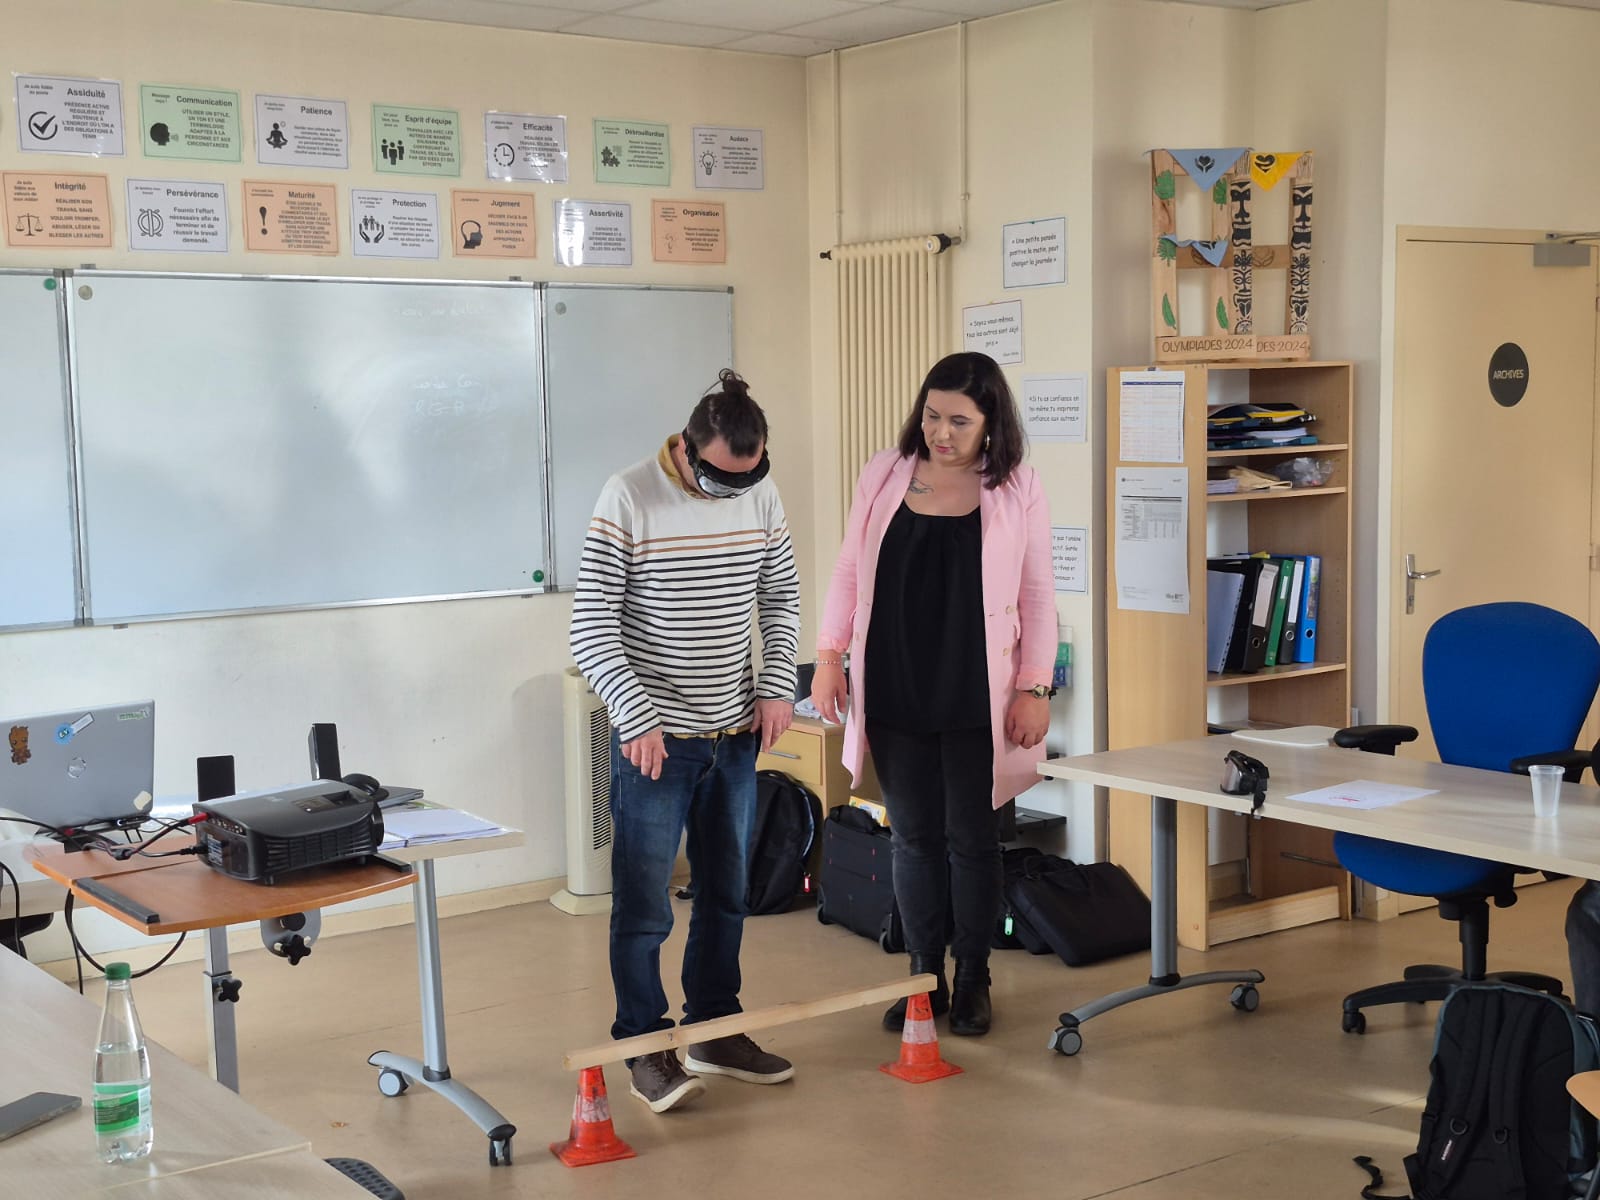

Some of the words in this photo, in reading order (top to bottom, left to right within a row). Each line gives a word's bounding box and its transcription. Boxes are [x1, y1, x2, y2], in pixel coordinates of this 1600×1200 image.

[67, 88, 106, 98] Assiduité
[177, 96, 232, 106] Communication
[301, 106, 332, 115] Patience
[405, 115, 424, 123] Esprit
[425, 117, 452, 126] d'équipe
[523, 123, 553, 131] Efficacité
[55, 182, 86, 191] Intégrité
[166, 188, 219, 198] Persévérance
[392, 199, 426, 208] Protection
[589, 209, 623, 218] Assertivité
[683, 209, 720, 217] Organisation
[1162, 339, 1222, 353] OLYMPIADES
[1225, 338, 1254, 350] 2024
[1277, 340, 1307, 351] 2024
[1493, 369, 1524, 379] ARCHIVES
